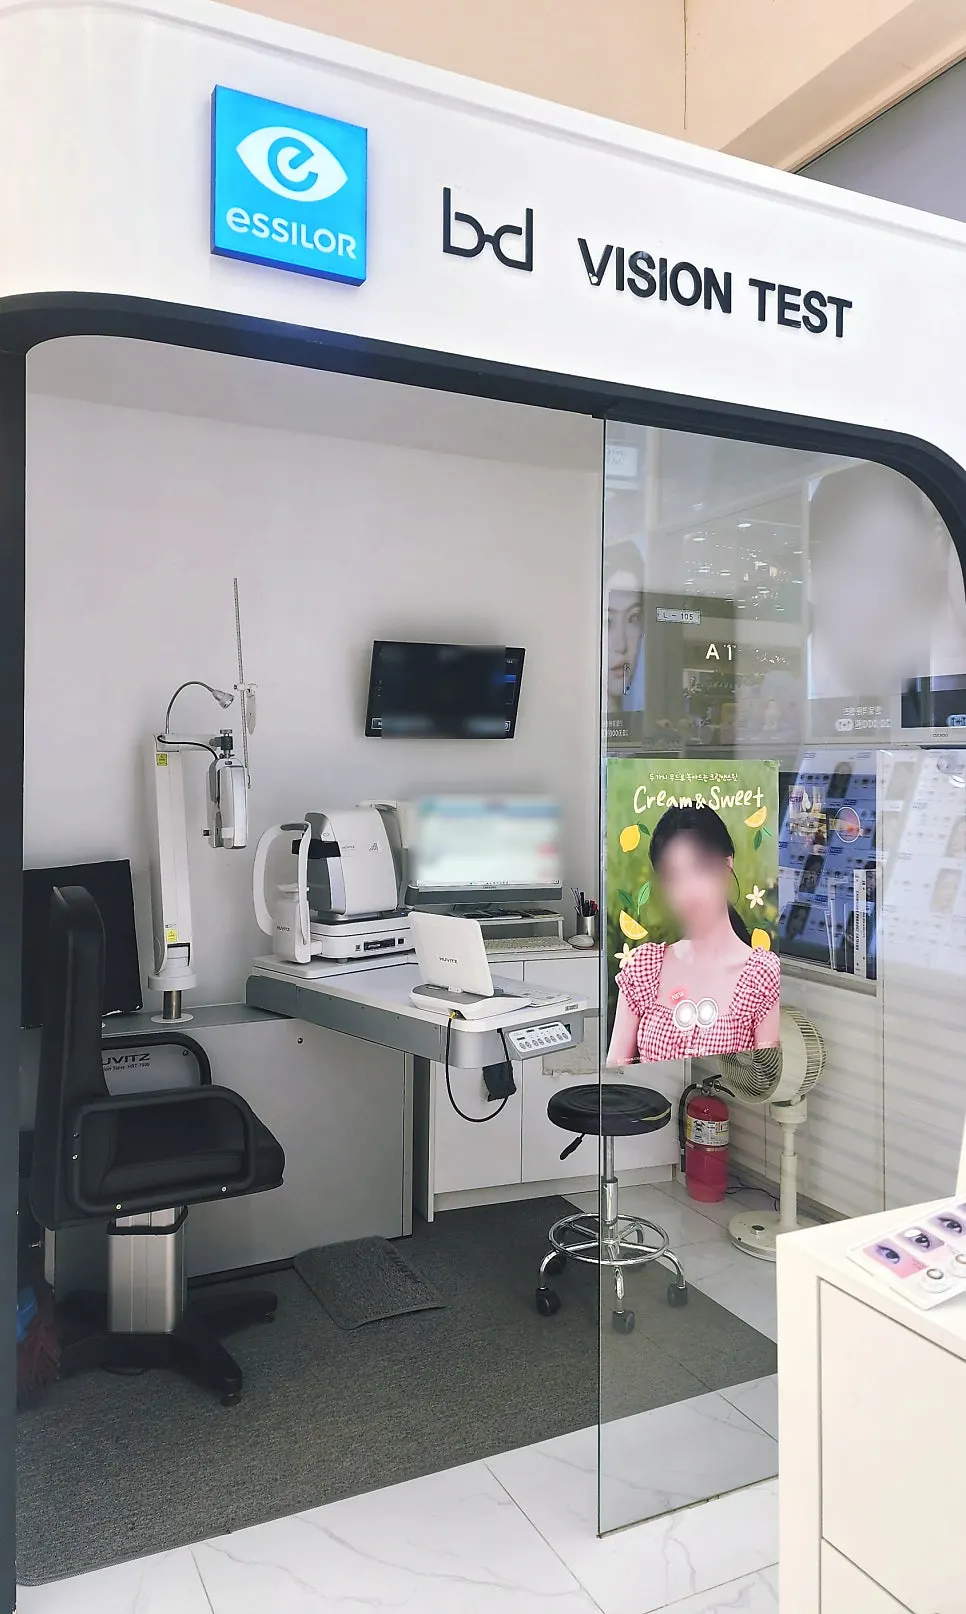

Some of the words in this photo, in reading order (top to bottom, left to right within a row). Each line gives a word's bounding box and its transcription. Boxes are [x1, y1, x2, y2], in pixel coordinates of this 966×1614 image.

[577, 237, 732, 315] VISION
[748, 278, 853, 339] TEST
[681, 612, 694, 621] 105
[101, 1053, 151, 1066] UVITZ
